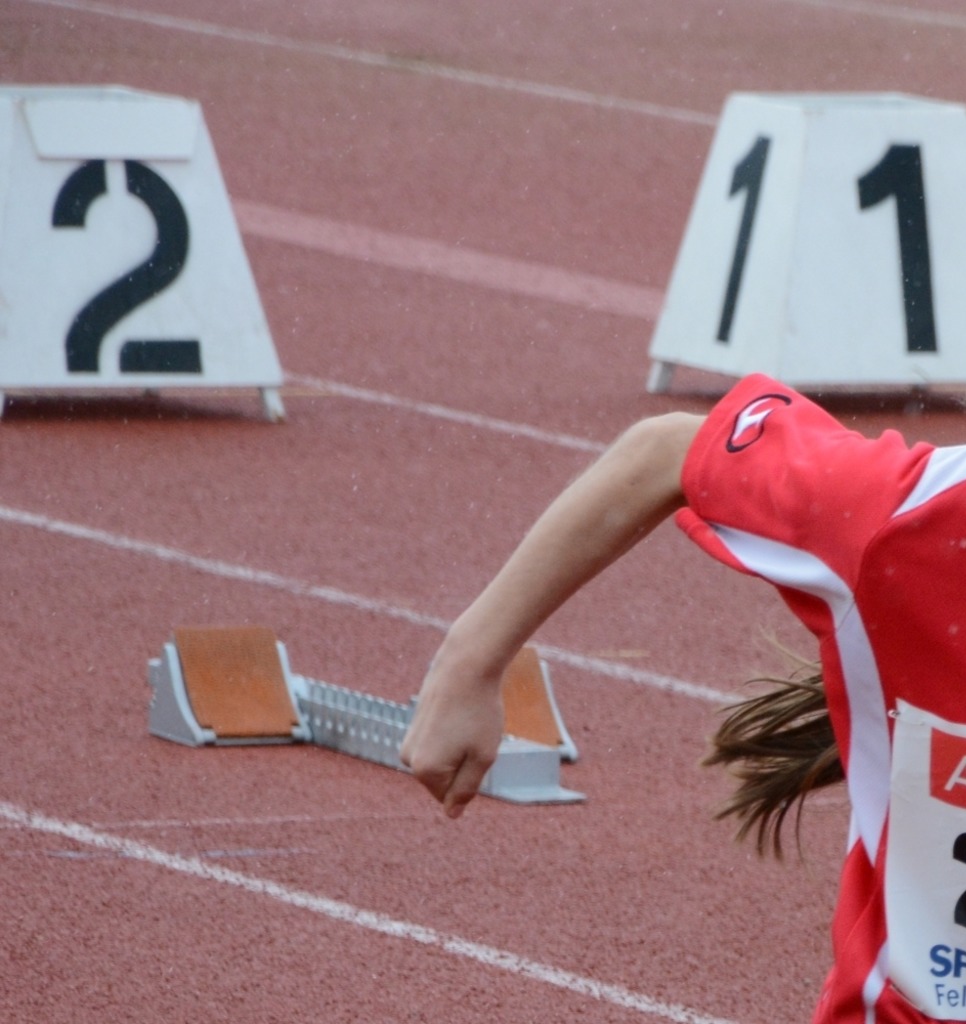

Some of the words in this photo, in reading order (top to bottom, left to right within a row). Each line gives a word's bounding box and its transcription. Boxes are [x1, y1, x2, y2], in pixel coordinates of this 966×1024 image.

[52, 158, 203, 374] 2
[716, 136, 772, 344] 1
[857, 143, 938, 353] 1
